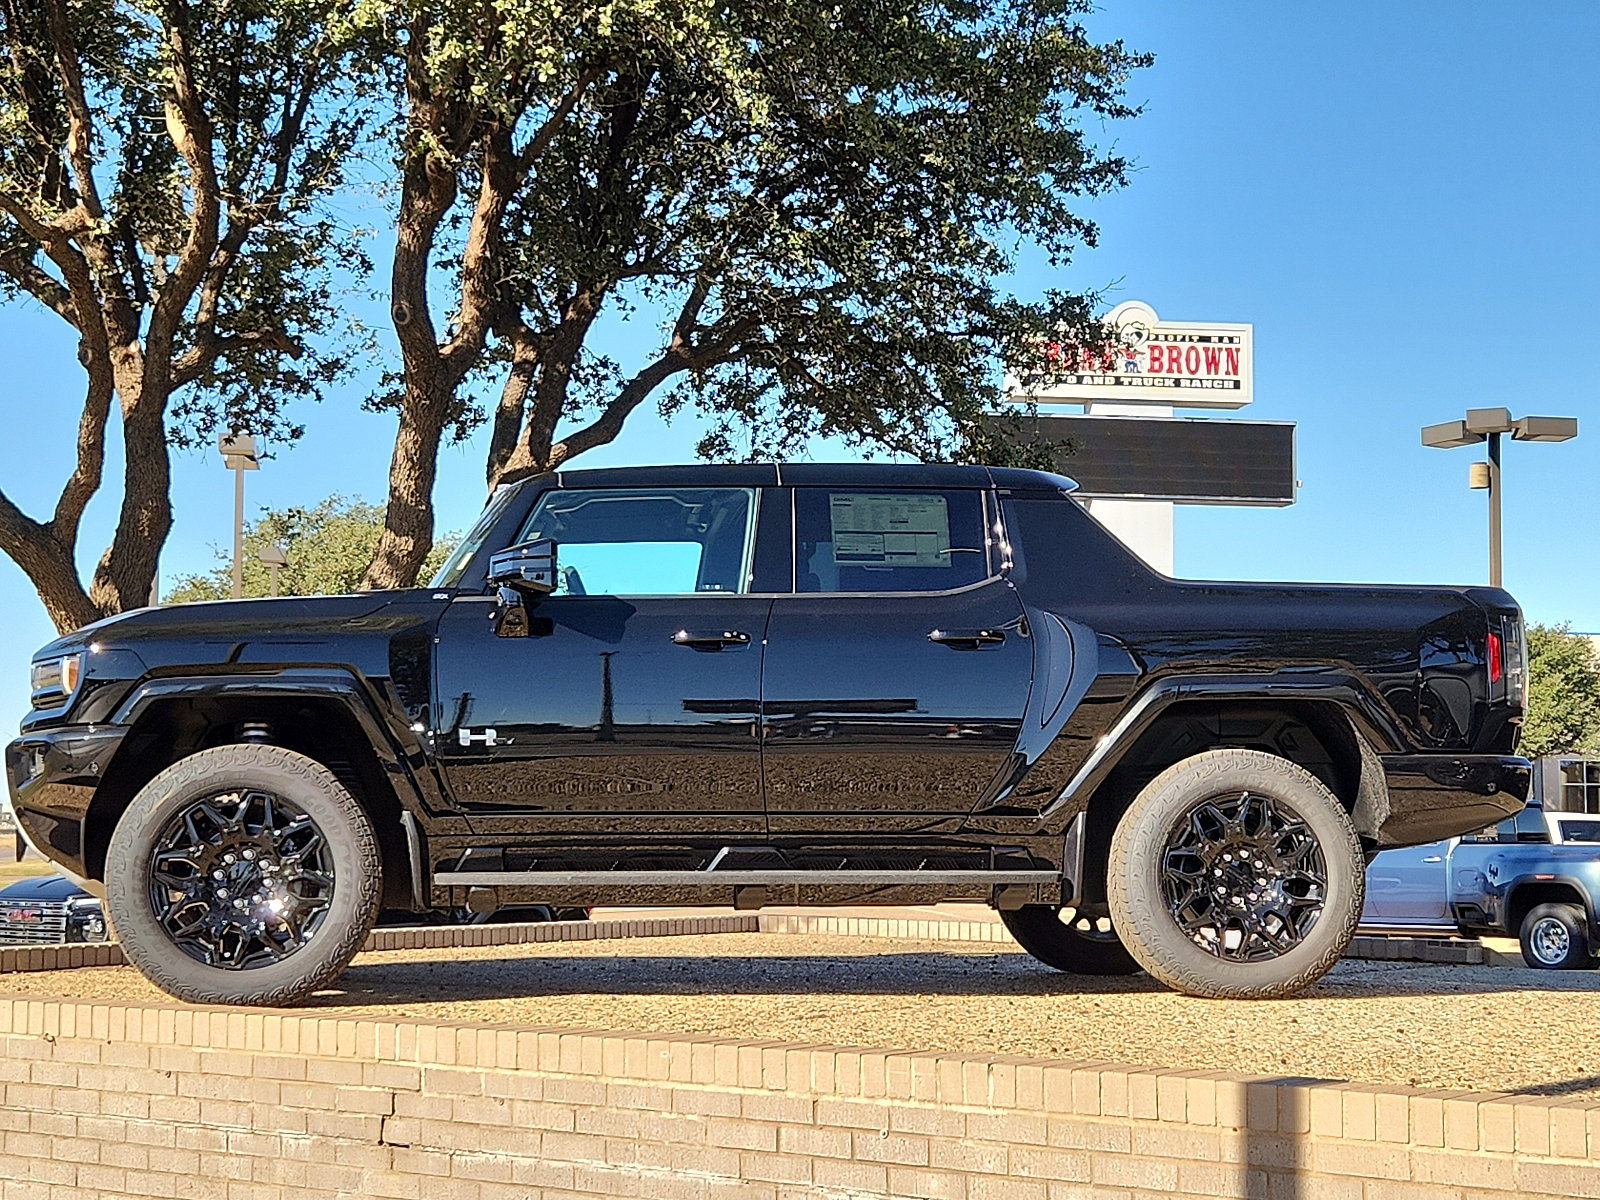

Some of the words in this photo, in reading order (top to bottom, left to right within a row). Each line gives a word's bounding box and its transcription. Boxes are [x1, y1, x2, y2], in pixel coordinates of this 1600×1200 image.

[1149, 334, 1200, 343] PROFIT
[1210, 336, 1240, 344] MAN
[1147, 344, 1240, 376] BROWN
[1081, 375, 1116, 385] AND
[1120, 376, 1175, 387] TRUCK
[1180, 379, 1235, 389] RANCH
[303, 795, 352, 906] GOODYEAR
